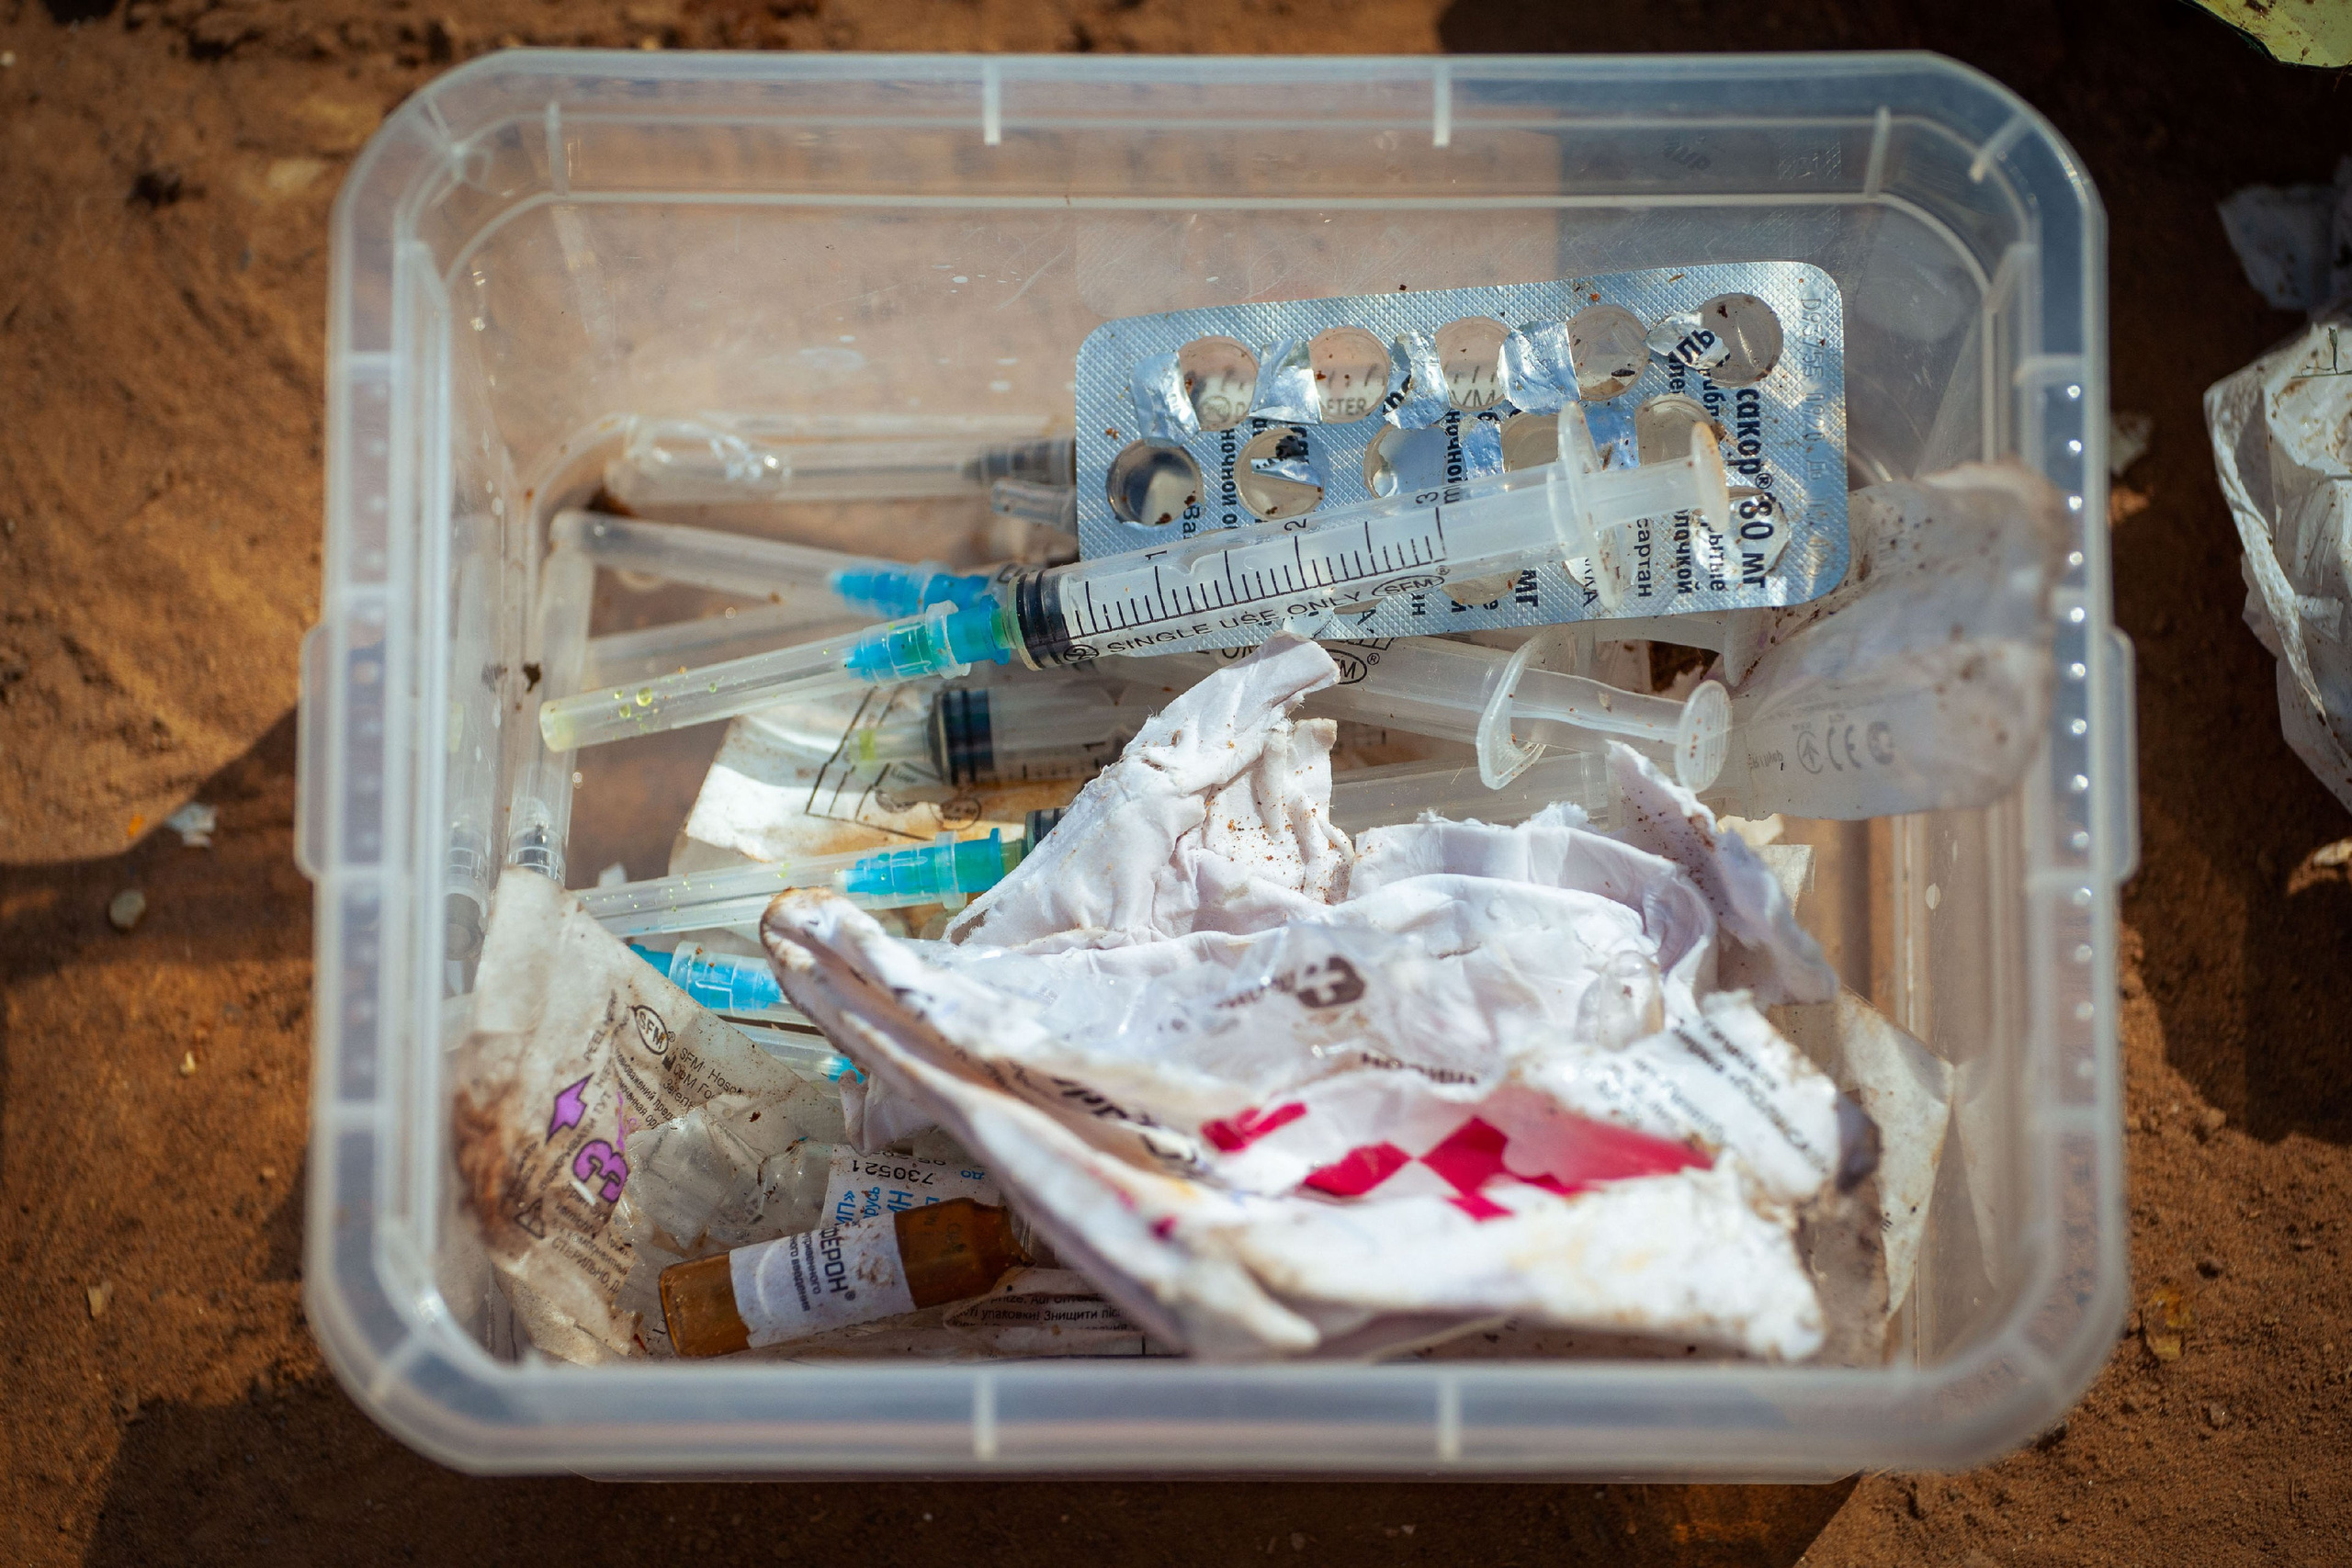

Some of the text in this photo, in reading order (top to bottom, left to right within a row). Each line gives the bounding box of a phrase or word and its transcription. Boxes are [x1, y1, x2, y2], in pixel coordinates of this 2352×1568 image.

[1283, 517, 1307, 532] 2
[1416, 491, 1439, 504] 3
[1738, 499, 1774, 540] 80
[1675, 509, 1700, 595] лочкой
[1107, 591, 1361, 653] SINGLE USE ONLY
[679, 1047, 705, 1073] SFM
[852, 1159, 934, 1185] 730521
[1044, 1310, 1098, 1322] Знищити
